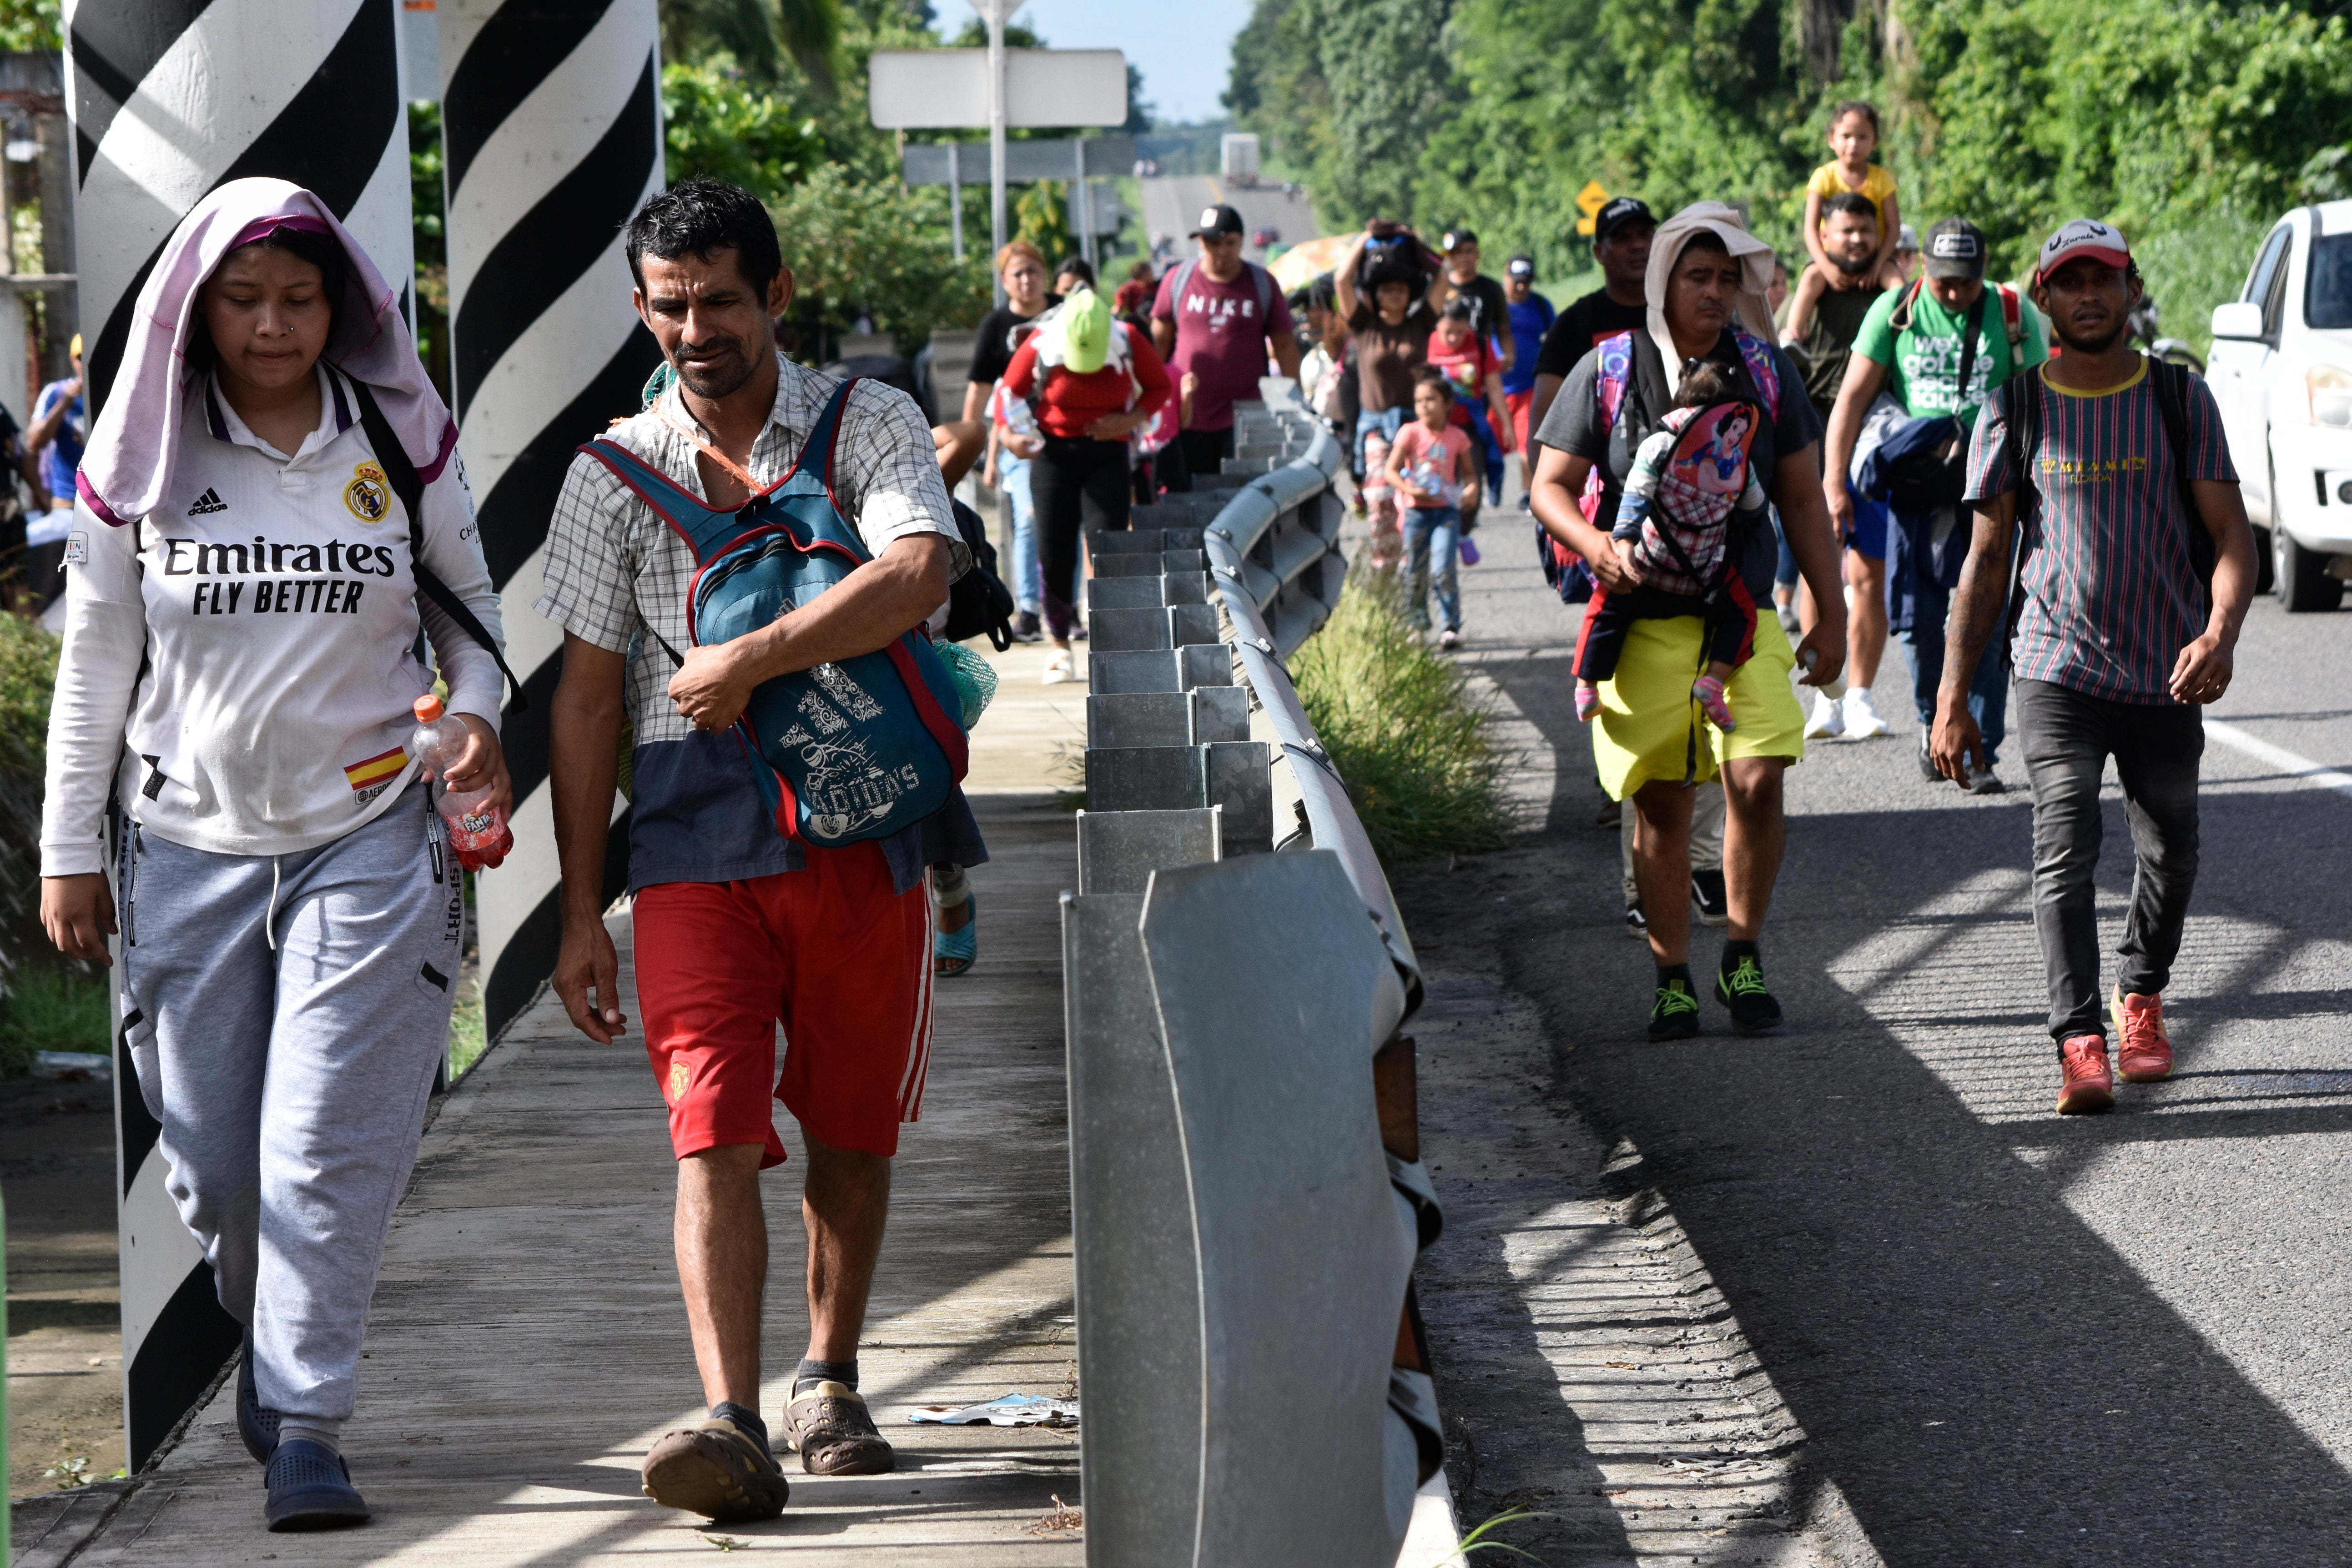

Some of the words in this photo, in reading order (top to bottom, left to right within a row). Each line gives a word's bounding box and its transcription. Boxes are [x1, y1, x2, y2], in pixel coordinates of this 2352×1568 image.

[1187, 294, 1254, 318] NIKE
[1903, 352, 1947, 378] got
[2060, 459, 2127, 472] MIAMI
[2070, 473, 2111, 483] FLORIDA
[188, 503, 228, 516] adidas
[164, 535, 395, 577] Emirates
[193, 582, 246, 615] FLY
[253, 580, 364, 614] BETTER
[464, 814, 491, 832] FANTA
[444, 867, 461, 945] SPORT
